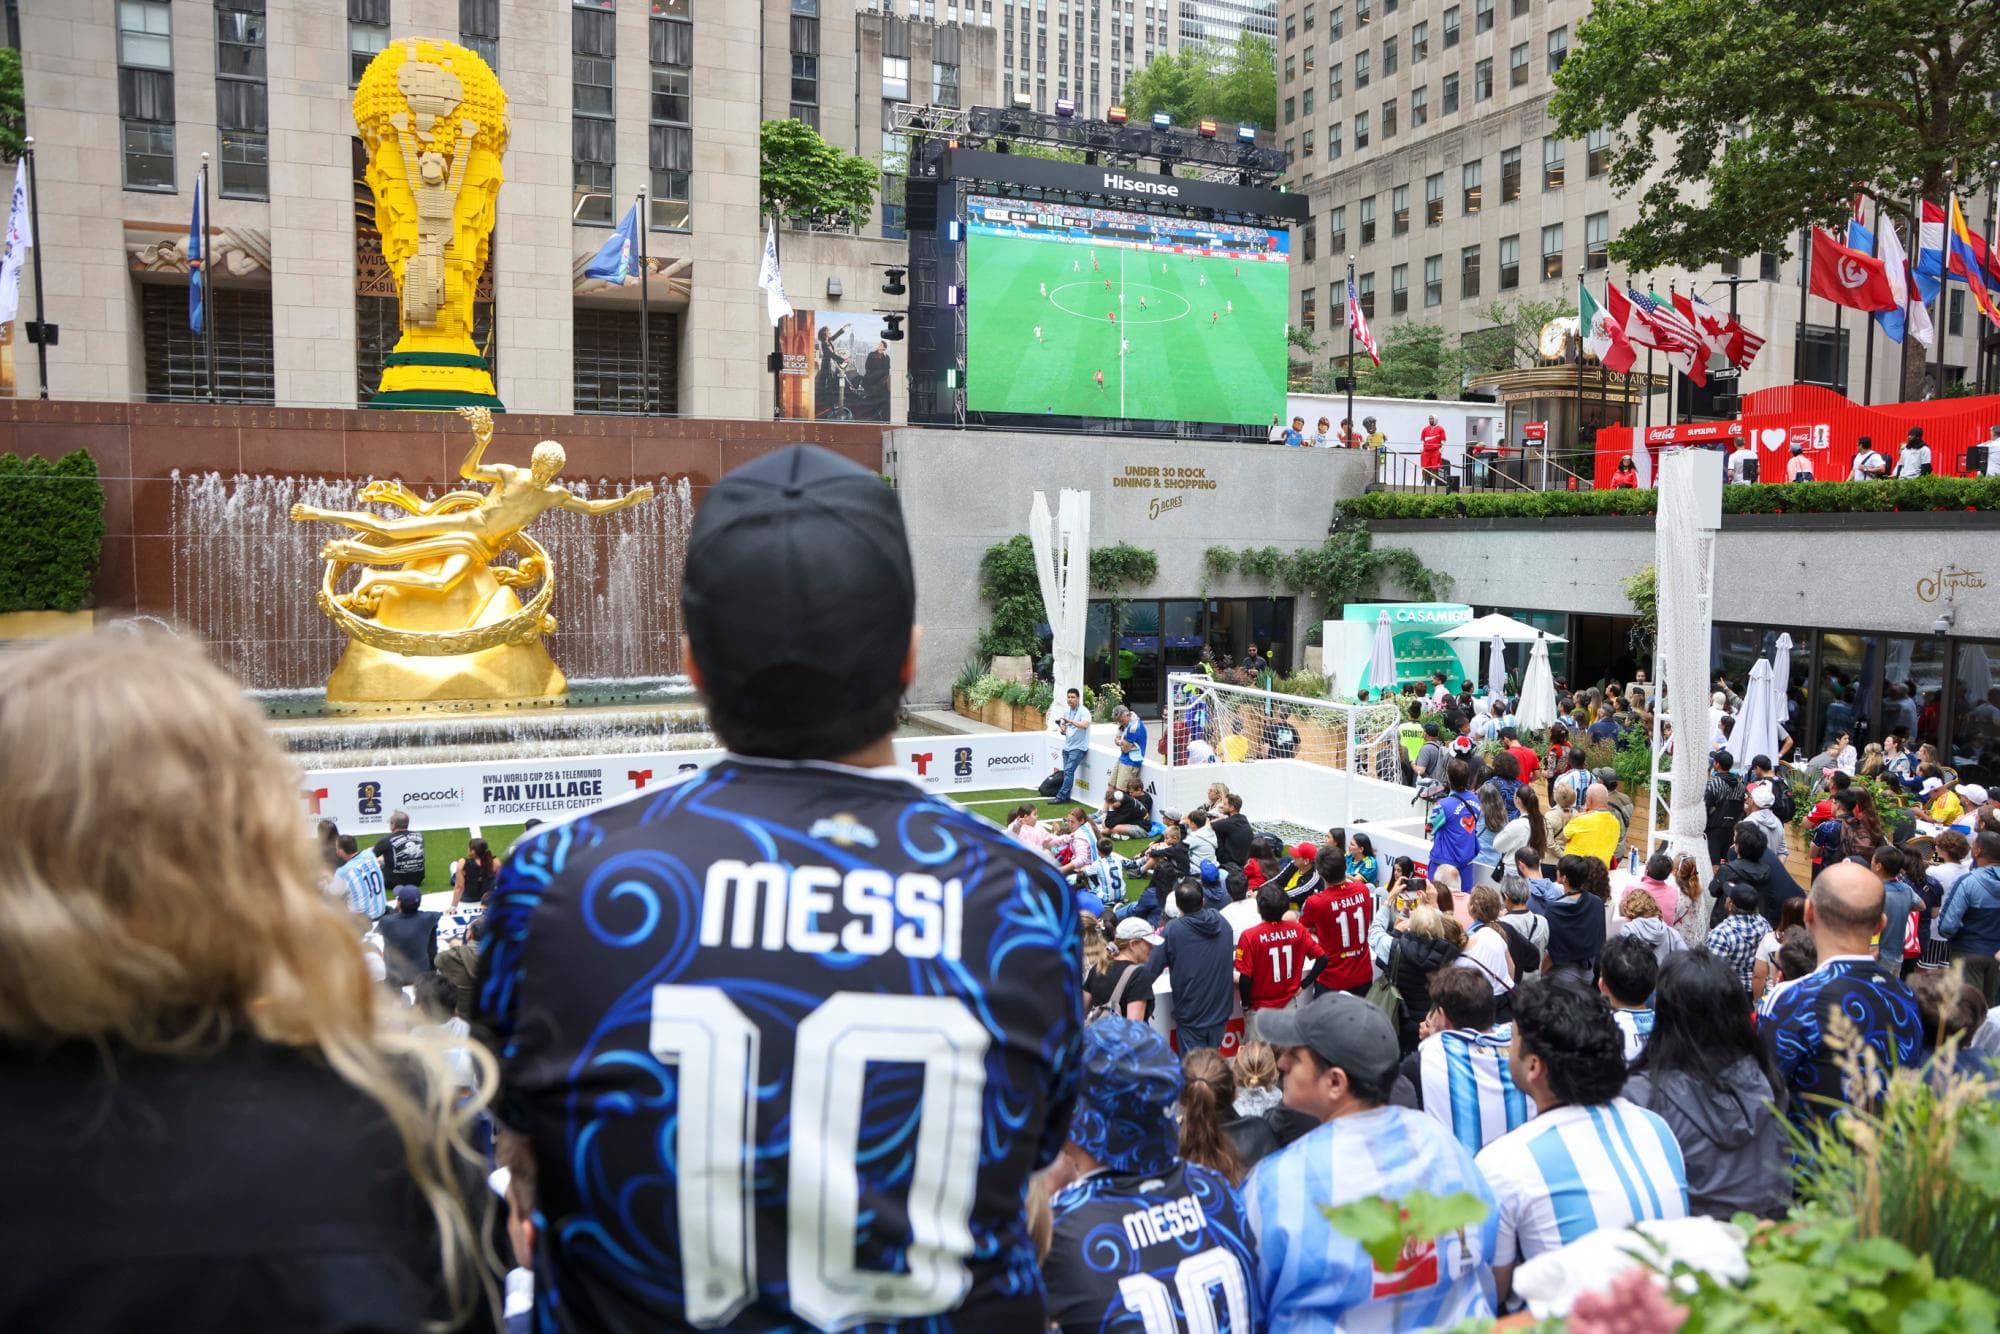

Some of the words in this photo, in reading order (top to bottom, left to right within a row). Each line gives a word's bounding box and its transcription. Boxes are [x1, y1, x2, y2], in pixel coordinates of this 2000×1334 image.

[1103, 173, 1179, 197] Hisense
[359, 281, 397, 293] STABIL
[782, 361, 792, 369] HE
[1650, 428, 1676, 441] Coca-Cola
[1124, 466, 1160, 477] UNDER
[1161, 467, 1176, 477] 30
[1177, 468, 1207, 478] ROCK
[1112, 477, 1152, 488] DINING
[1153, 479, 1162, 488] &
[1164, 479, 1217, 490] SHOPPING
[1149, 497, 1160, 521] 5
[1160, 496, 1183, 511] ACRES
[987, 753, 1030, 767] peacock
[482, 775, 502, 784] NYNJ
[503, 773, 528, 783] WORLD
[529, 772, 543, 782] CUP
[544, 771, 554, 780] 26
[555, 771, 561, 780] &
[562, 769, 602, 779] TELEMUNDO
[402, 787, 459, 805] peacock
[483, 785, 520, 802] FAN
[524, 780, 602, 800] VILLAGE
[484, 804, 496, 814] AT
[499, 801, 564, 813] ROCKEFELLER
[1413, 863, 1429, 874] Len
[363, 871, 382, 898] 10
[698, 858, 964, 963] MESSI
[1336, 906, 1365, 948] 11
[1269, 944, 1293, 983] 11
[650, 980, 992, 1334] 10
[1123, 1193, 1208, 1251] MESSI
[1118, 1245, 1252, 1334] 10
